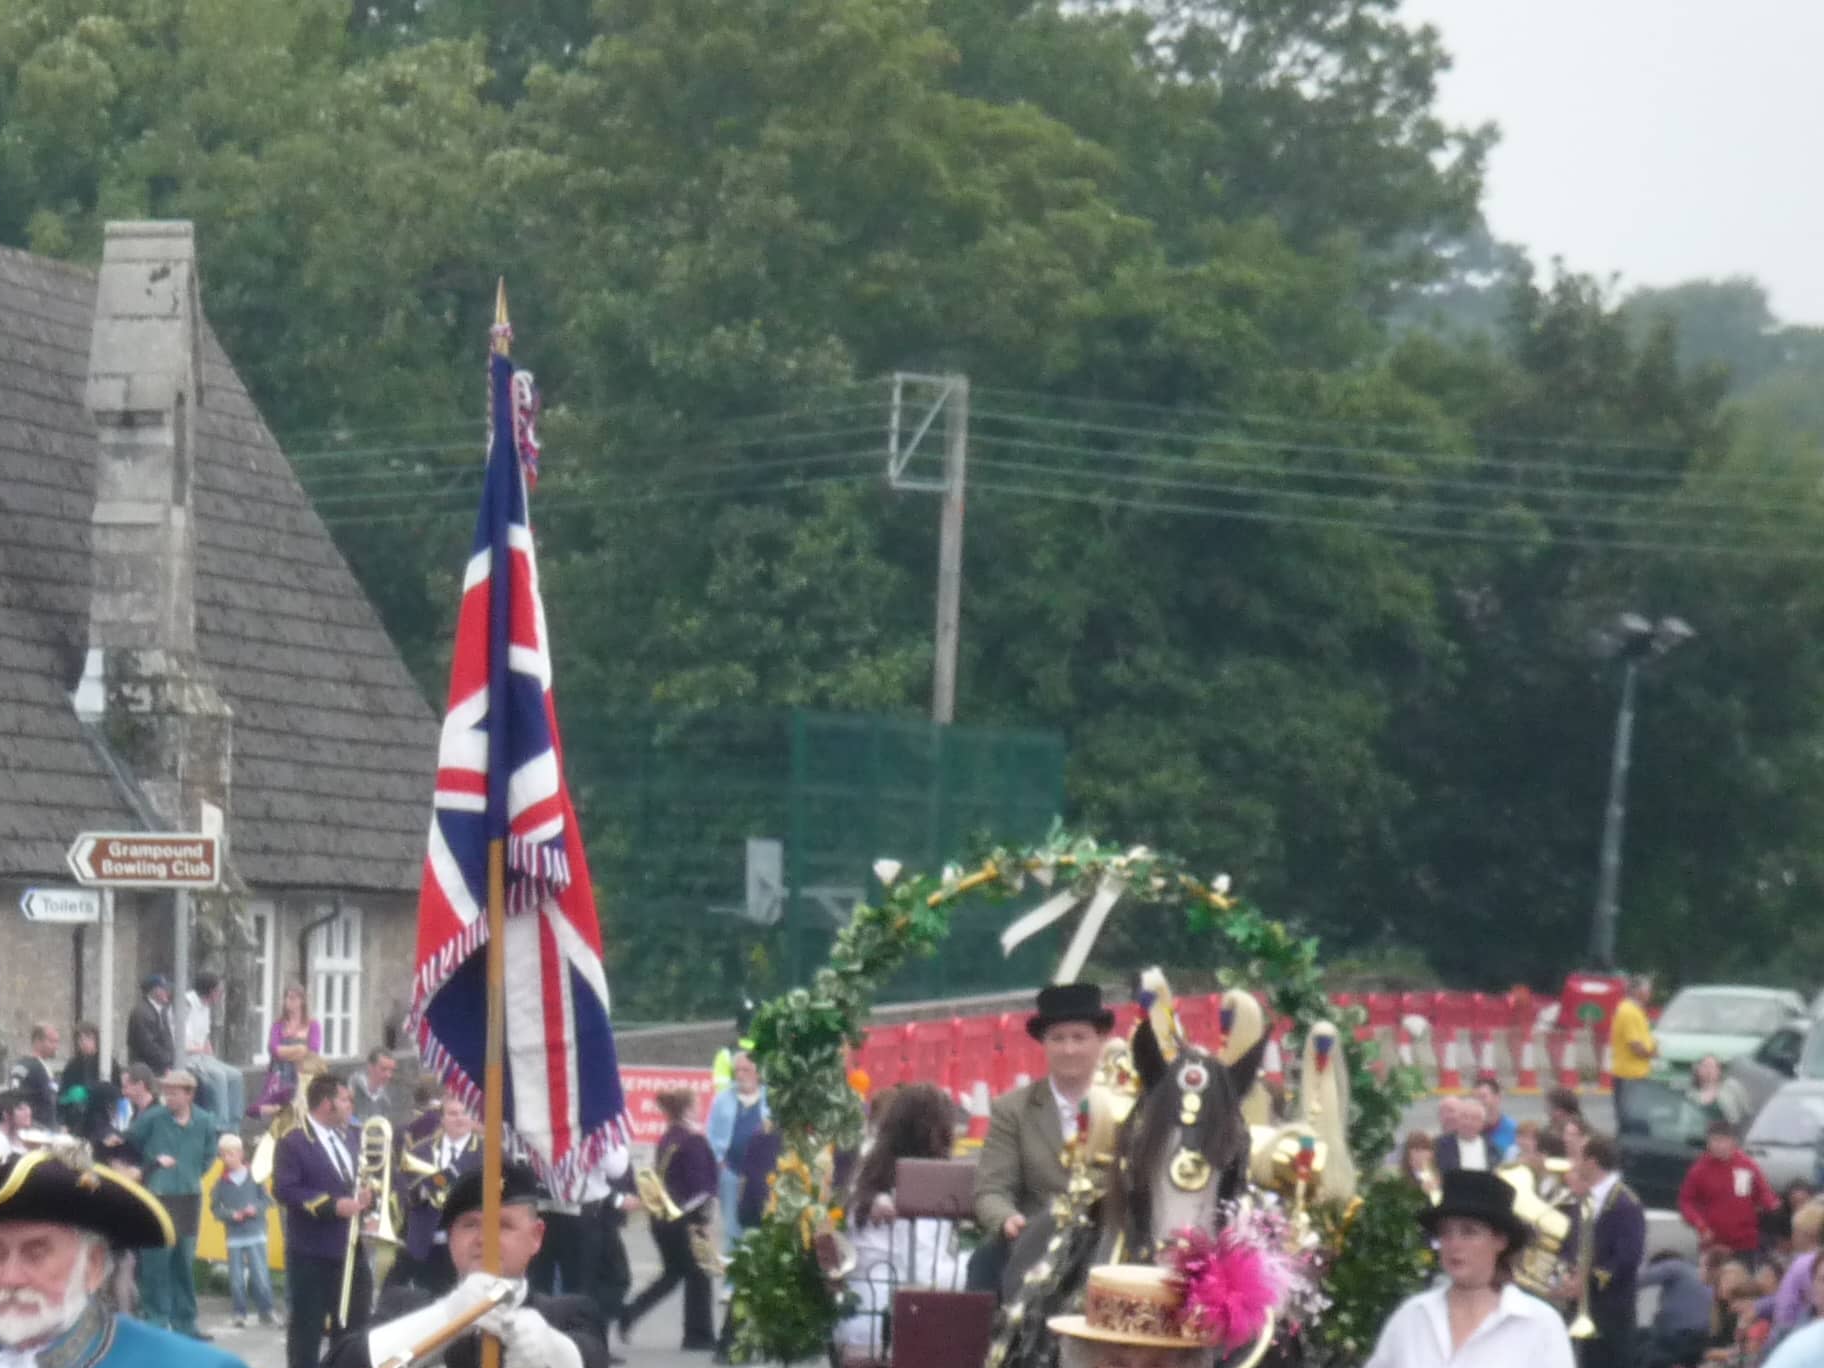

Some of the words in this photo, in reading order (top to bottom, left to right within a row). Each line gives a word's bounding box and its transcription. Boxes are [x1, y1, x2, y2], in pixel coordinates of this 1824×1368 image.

[108, 841, 203, 860] Grampound
[102, 859, 167, 880] Bowling
[172, 859, 211, 876] Club
[43, 897, 94, 913] Toilets
